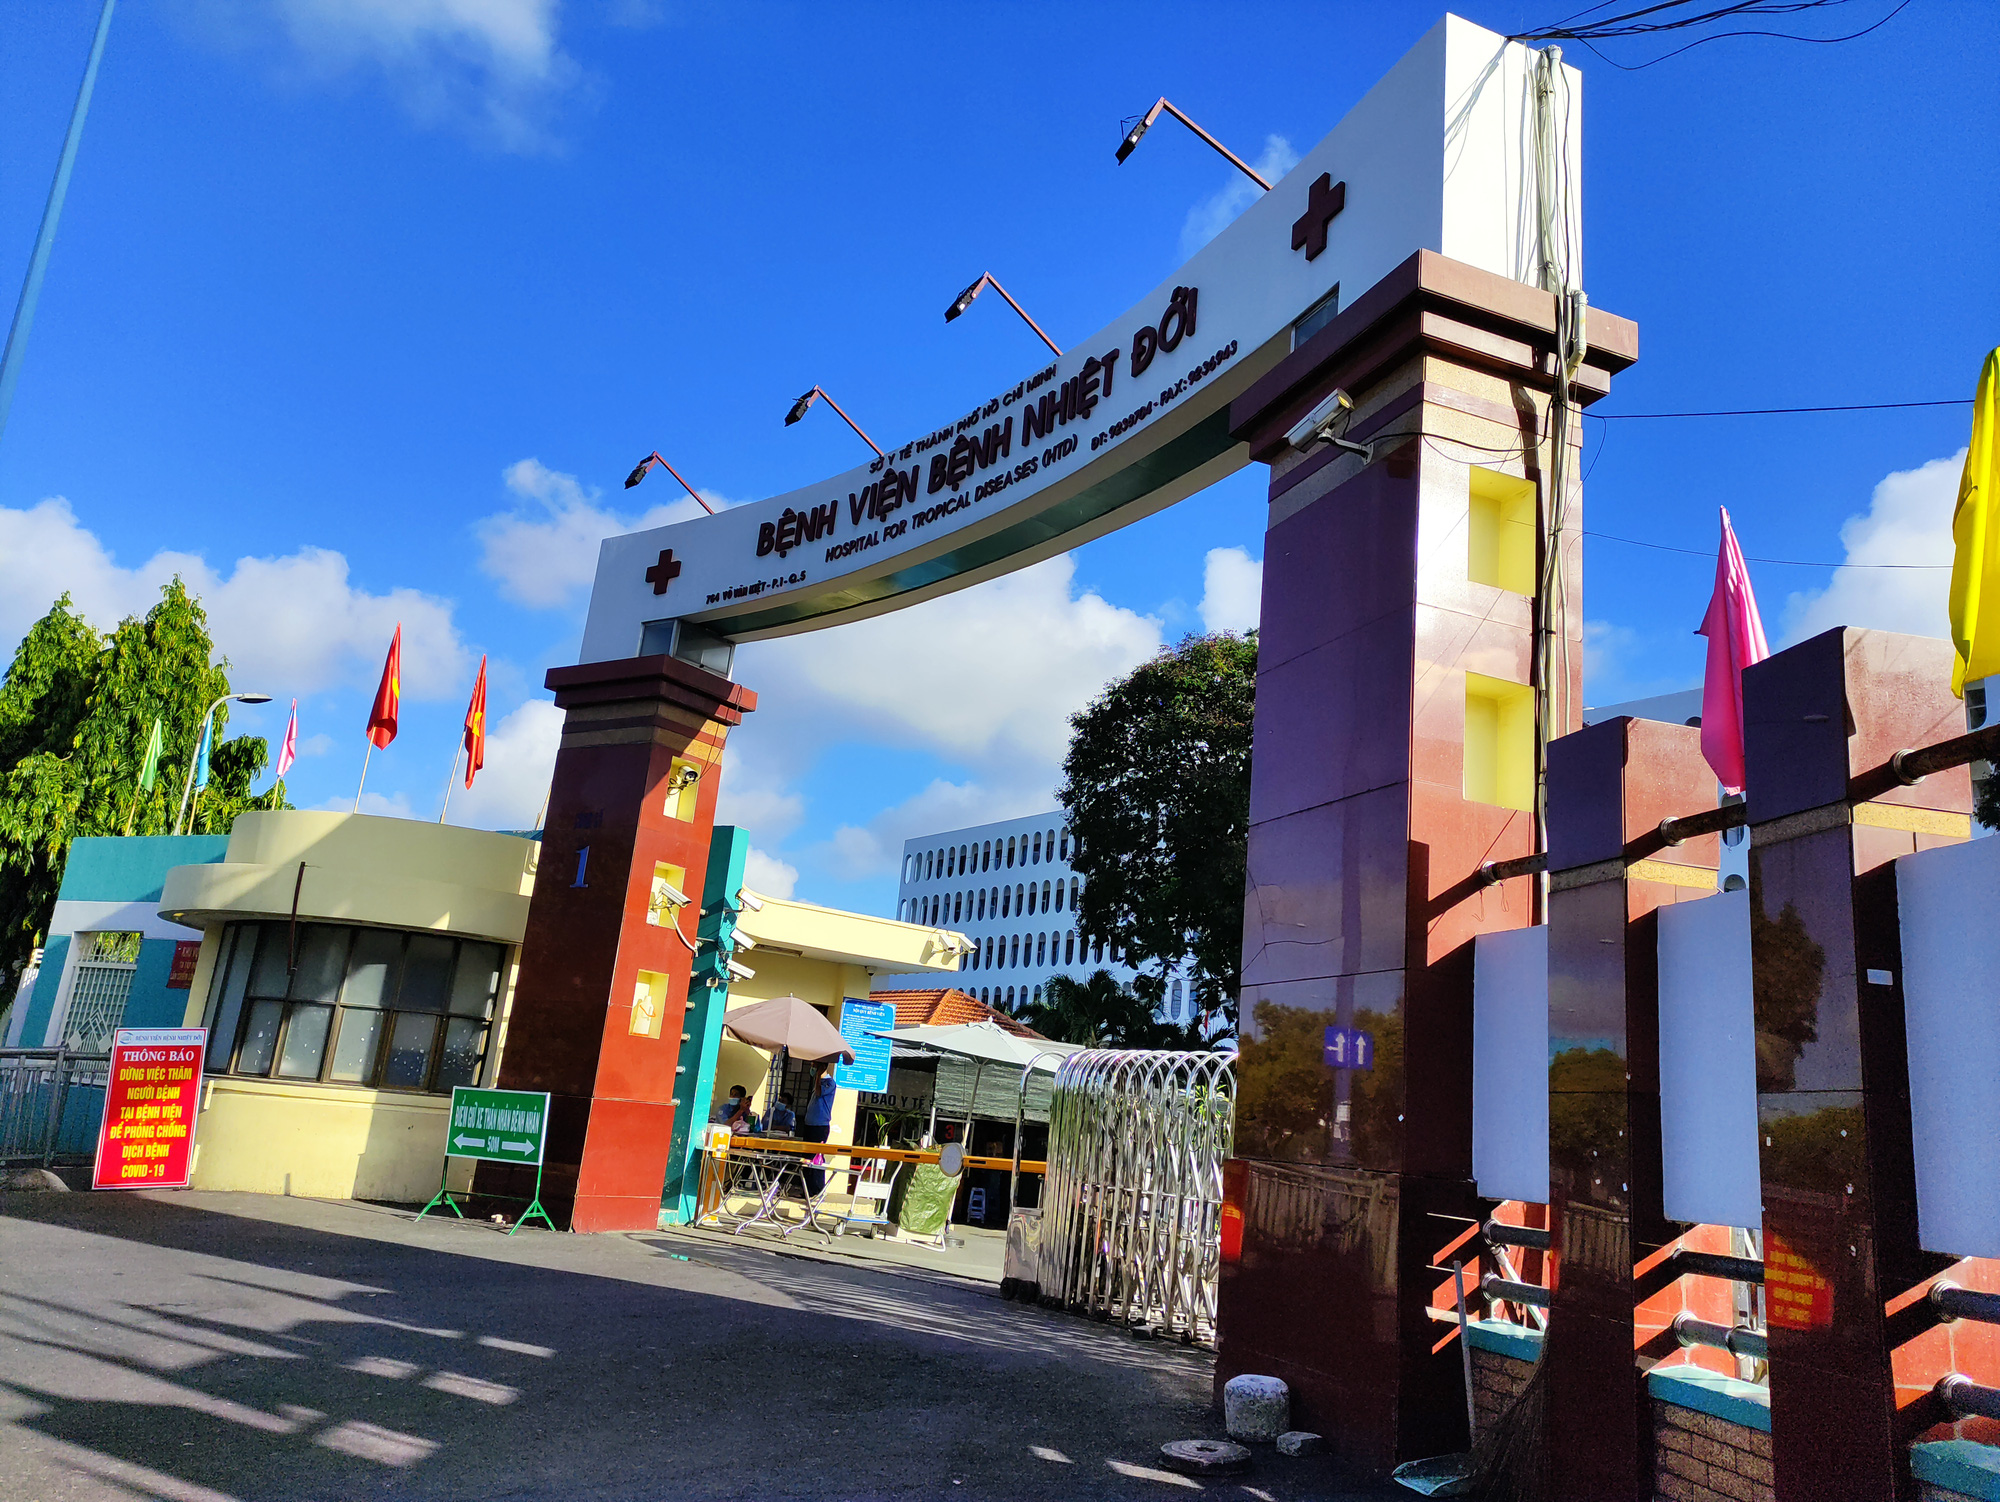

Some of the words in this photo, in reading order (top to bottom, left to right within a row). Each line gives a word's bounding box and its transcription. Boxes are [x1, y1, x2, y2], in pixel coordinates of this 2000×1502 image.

[756, 500, 838, 558] BỆNH
[849, 465, 920, 522] VIỆN
[927, 416, 1013, 492] BỆNH
[1022, 348, 1120, 447] NHIỆT
[1130, 286, 1198, 378] ĐỚI
[869, 455, 884, 473] SỞ
[888, 453, 896, 466] Y
[899, 440, 914, 460] TẾ
[916, 426, 954, 454] THÀNH
[956, 406, 981, 434] PHỐ
[982, 398, 999, 420] HỒ
[1002, 381, 1024, 406] CHÍ
[1026, 364, 1056, 393] MINH
[825, 530, 880, 562] HOSPITAL
[883, 520, 908, 542] FOR
[912, 491, 970, 530] TROPICAL
[974, 457, 1038, 502] DISEASES
[1042, 434, 1078, 468] (HTD)
[570, 846, 590, 888] 1
[123, 1049, 166, 1062] THÔNG
[169, 1048, 194, 1061] BÁO
[120, 1066, 144, 1080] DỪNG
[147, 1066, 165, 1083] VIỆC
[168, 1066, 192, 1080] THĂM
[127, 1084, 154, 1100] NGƯỜI
[156, 1084, 180, 1101] BỆNH
[901, 1096, 908, 1107] Y
[121, 1106, 134, 1121] TẠI
[136, 1104, 160, 1121] BỆNH
[162, 1104, 182, 1121] VIỆN
[110, 1121, 124, 1139] ĐỂ
[124, 1123, 154, 1138] PHÒNG
[156, 1119, 186, 1138] CHỐNG
[945, 1124, 955, 1139] 3
[122, 1145, 143, 1161] DỊCH
[145, 1143, 170, 1160] BỆNH
